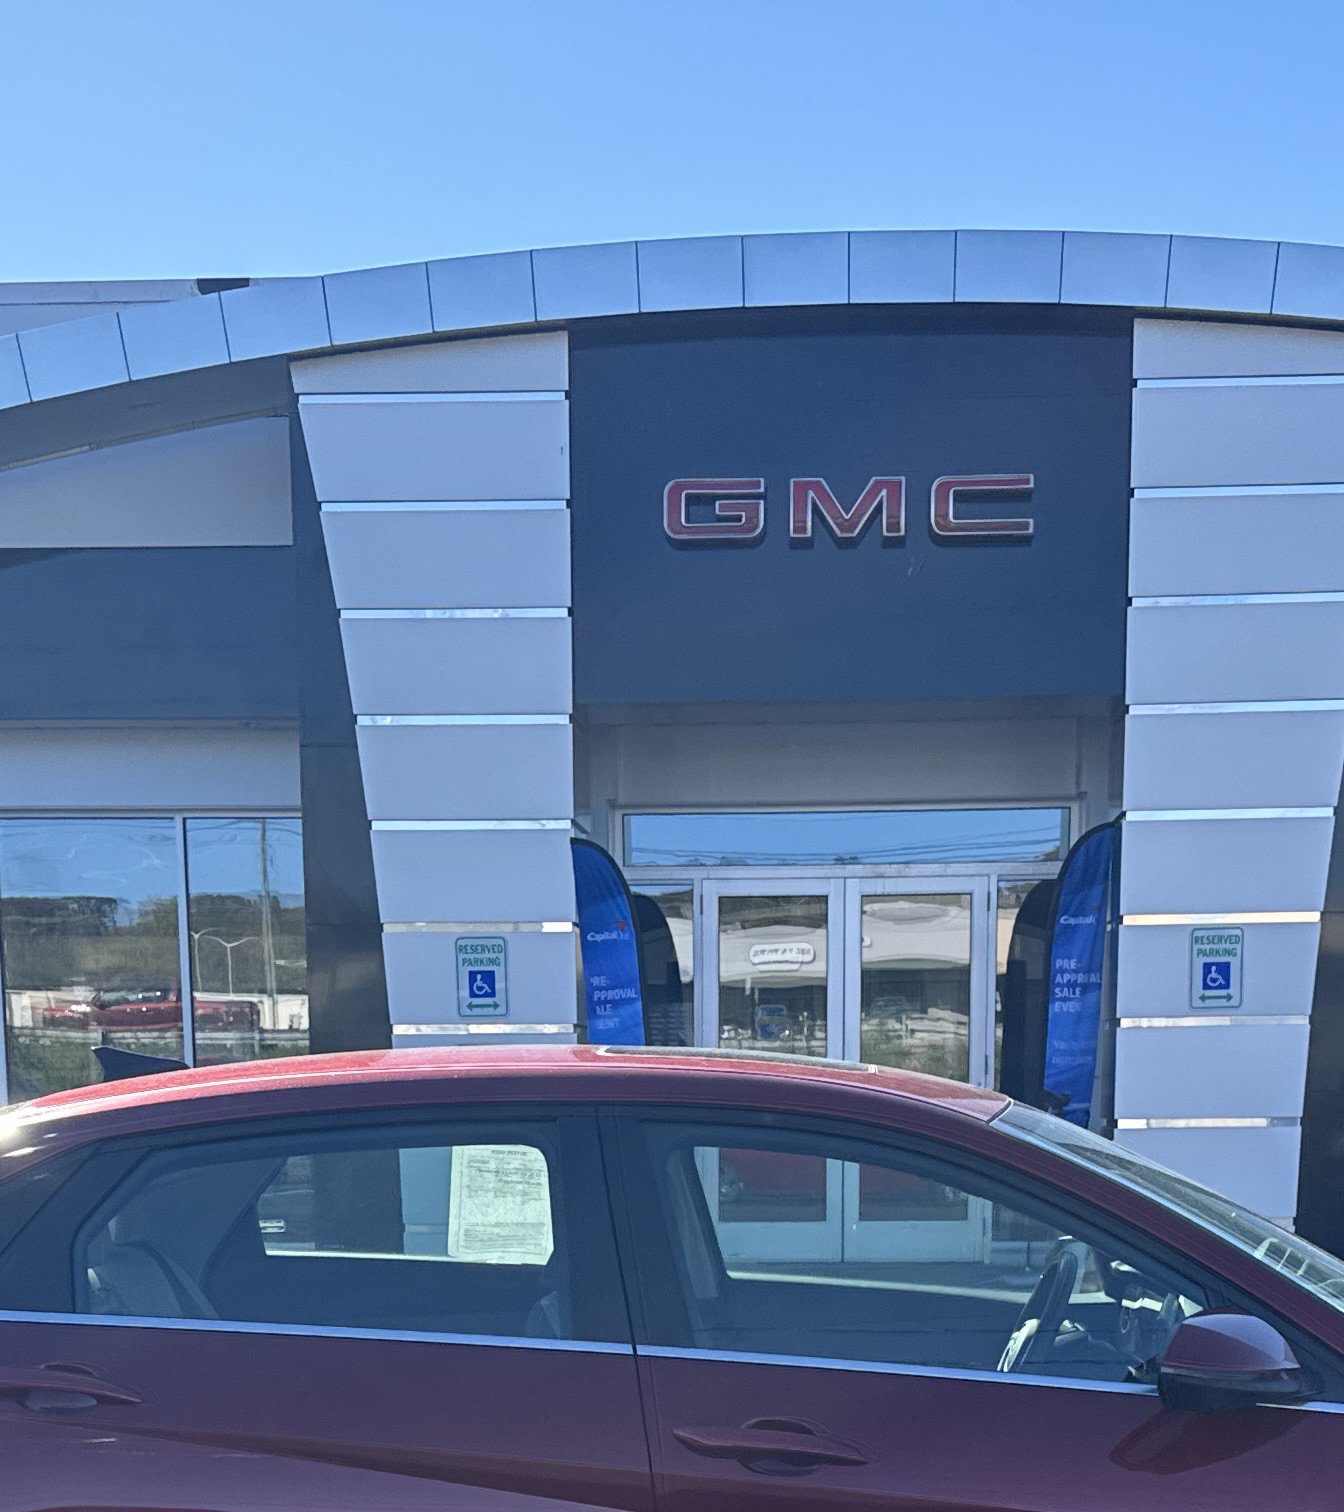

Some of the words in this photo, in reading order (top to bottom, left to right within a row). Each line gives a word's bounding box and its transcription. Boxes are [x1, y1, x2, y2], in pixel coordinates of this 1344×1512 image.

[663, 474, 1035, 539] GMC
[1194, 934, 1241, 945] RESERVED
[458, 943, 503, 955] RESERVED
[1197, 947, 1237, 957] PARKING
[462, 956, 501, 967] PARKING
[1055, 958, 1081, 969] PRE-
[1055, 973, 1101, 983] APPRAL
[593, 988, 638, 1001] PPROVAL
[1055, 987, 1081, 998] SALE
